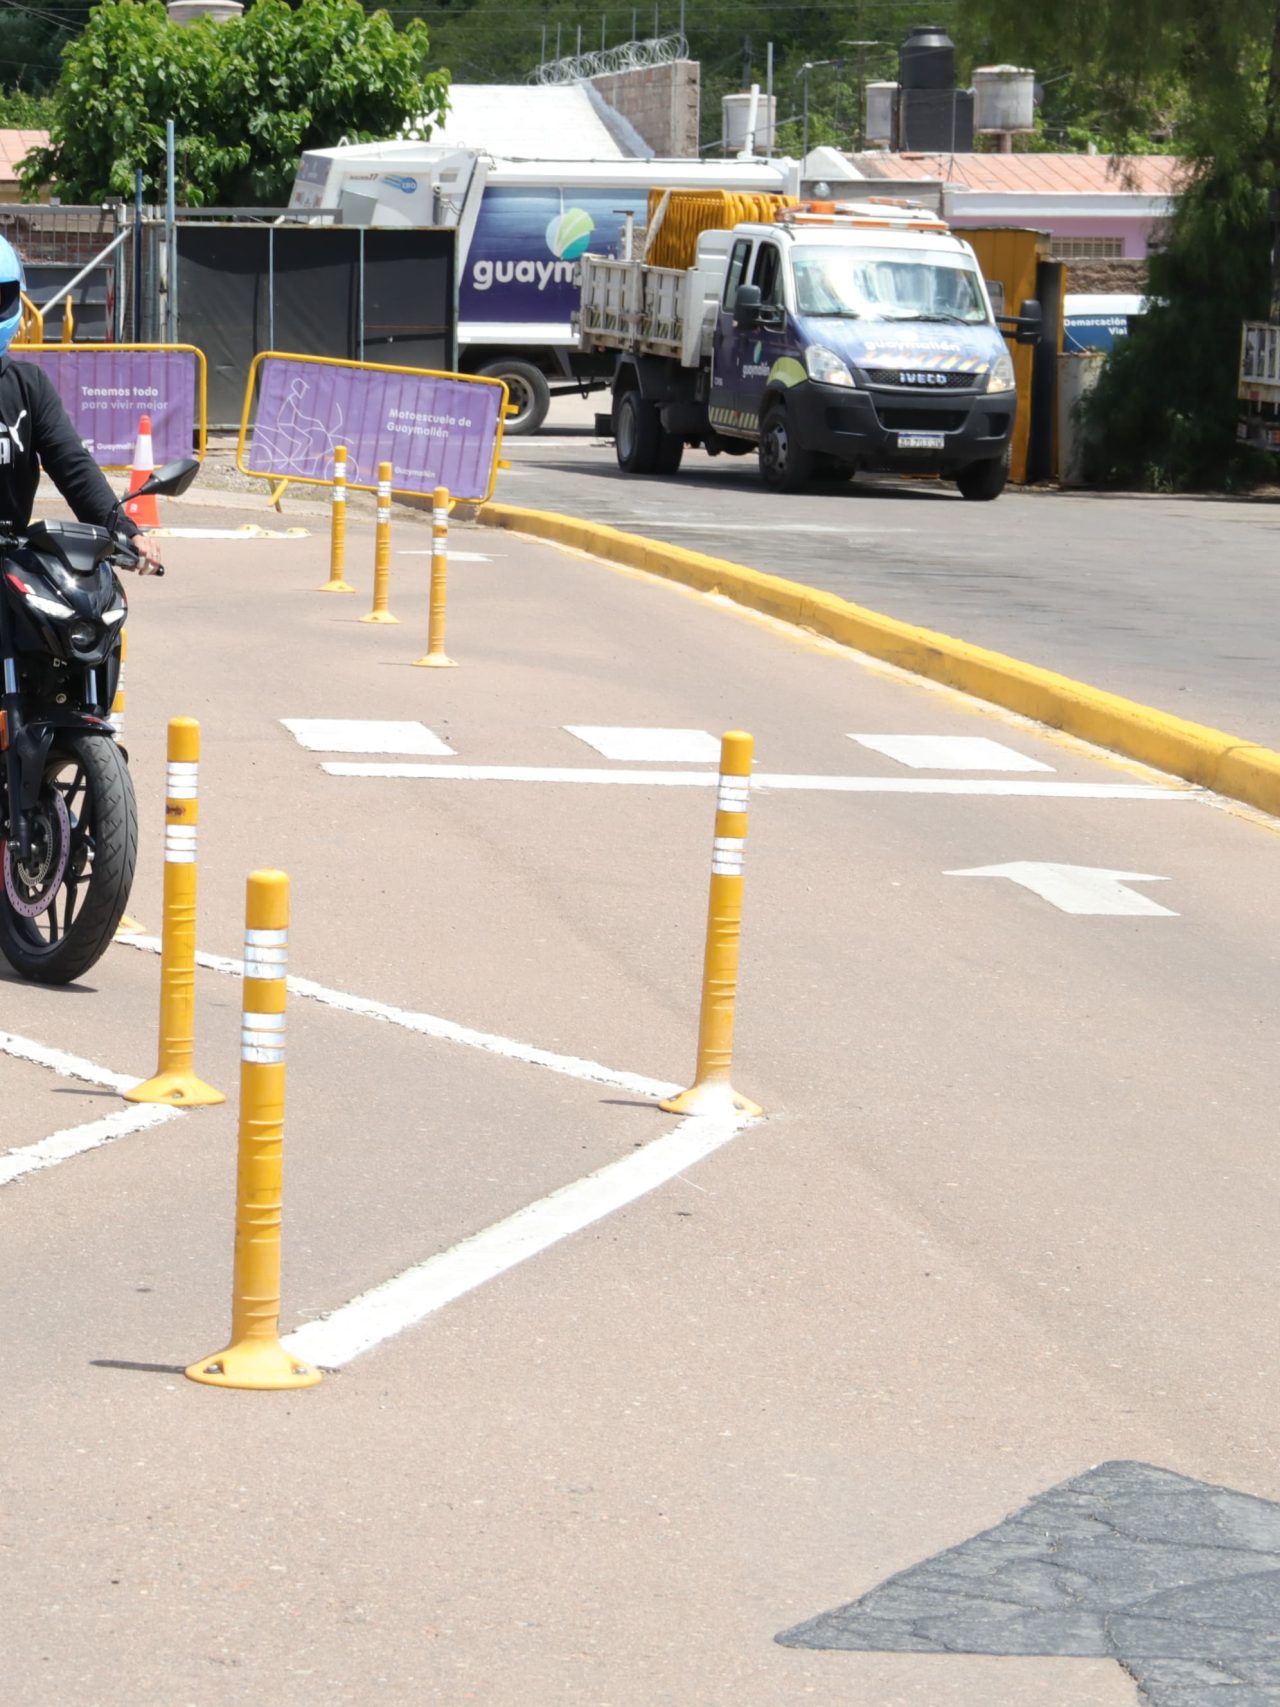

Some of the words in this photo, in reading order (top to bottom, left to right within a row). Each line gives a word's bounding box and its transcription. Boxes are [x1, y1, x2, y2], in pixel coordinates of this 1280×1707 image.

[1064, 317, 1128, 327] Demarcación
[1107, 327, 1128, 335] Vial
[899, 372, 947, 385] IVECO
[81, 386, 130, 396] Tenemos
[133, 386, 159, 396] todo
[81, 401, 108, 411] para
[111, 400, 135, 409] vivir
[136, 400, 169, 411] mejor
[388, 408, 456, 425] Motoescuela
[458, 416, 472, 428] de
[386, 421, 449, 438] Guaymallén
